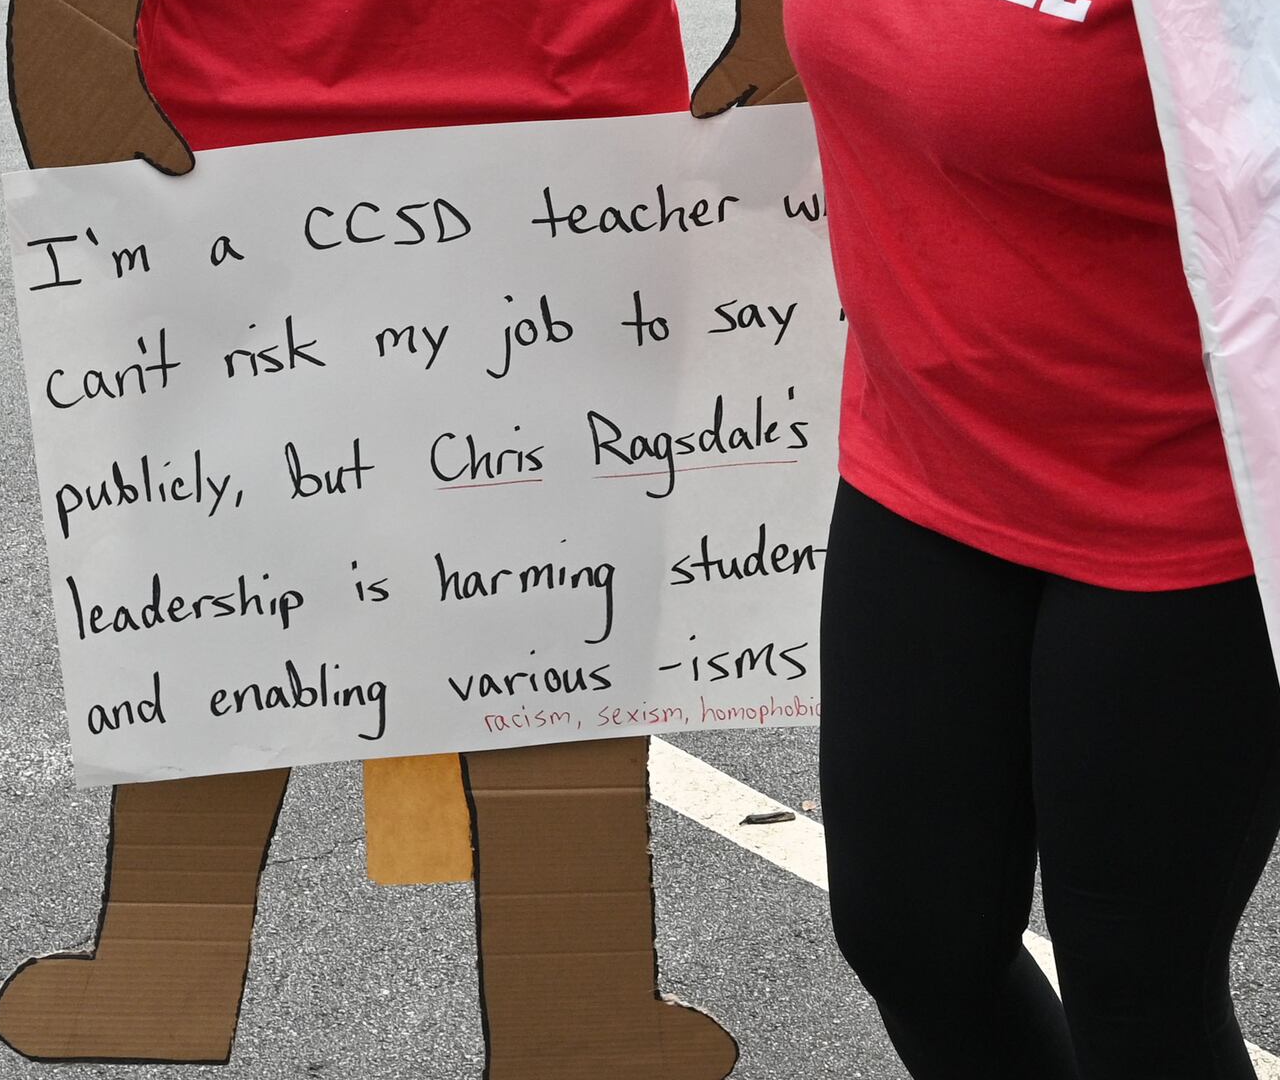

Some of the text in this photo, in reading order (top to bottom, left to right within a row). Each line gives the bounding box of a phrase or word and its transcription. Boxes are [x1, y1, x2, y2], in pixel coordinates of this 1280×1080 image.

[26, 226, 151, 291] I'm
[210, 235, 245, 267] a
[304, 198, 472, 250] CCSD
[531, 183, 740, 238] teacher
[46, 290, 798, 409] can't risk my job to say
[55, 385, 809, 540] publicly, but Chris Ragsdale's
[65, 572, 304, 640] leadership
[351, 560, 390, 602] is
[434, 540, 616, 645] harming
[87, 635, 808, 741] and enabling various -isms
[483, 708, 582, 734] racism,
[597, 700, 690, 727] sexism,
